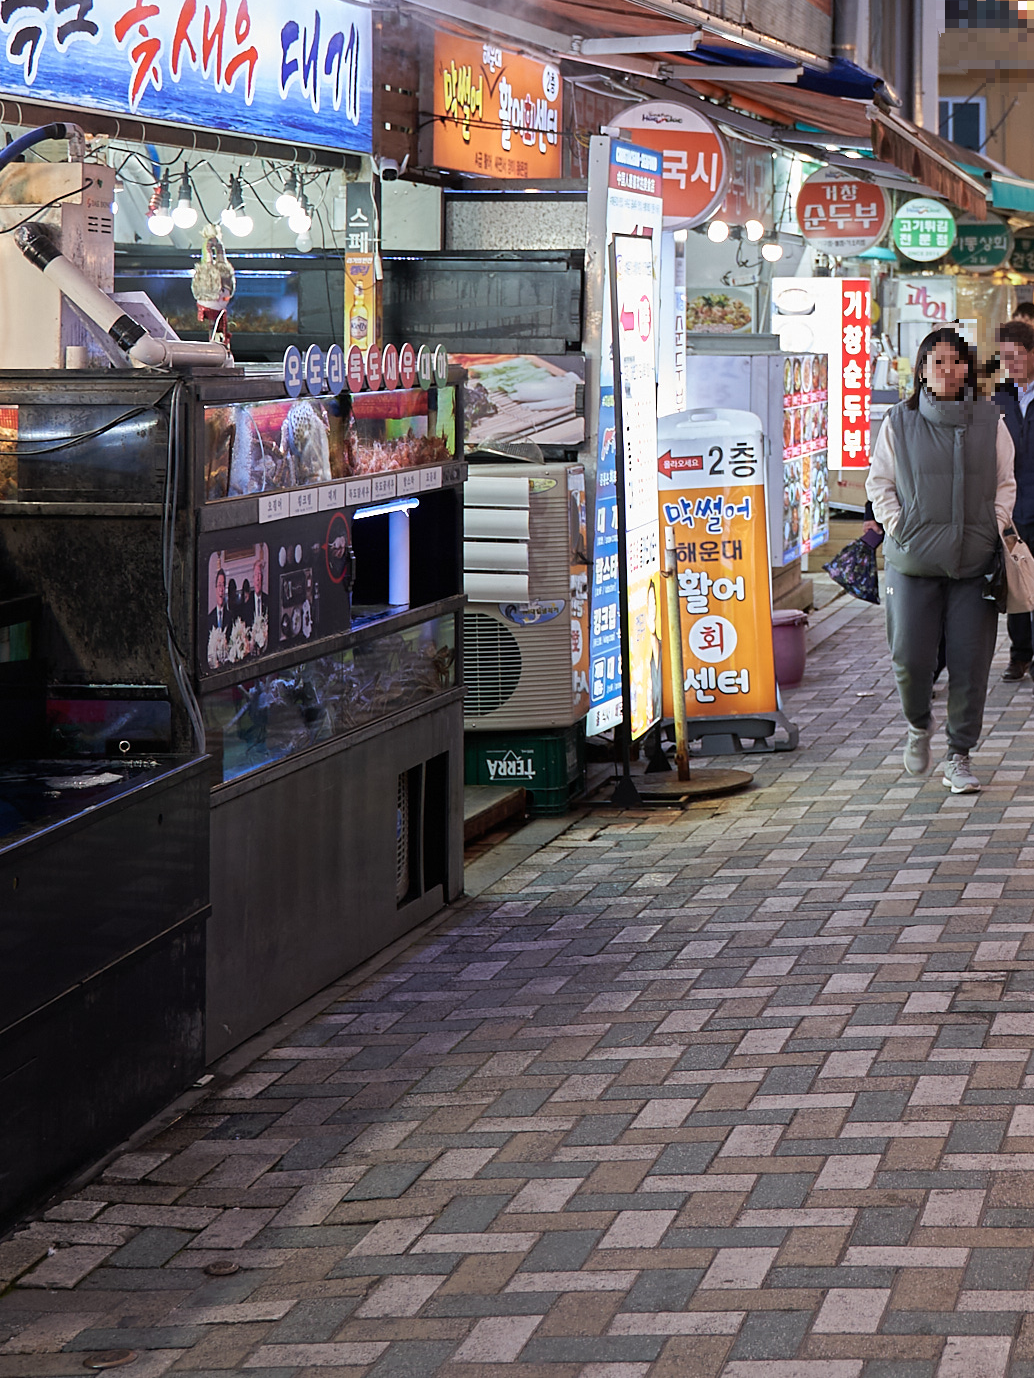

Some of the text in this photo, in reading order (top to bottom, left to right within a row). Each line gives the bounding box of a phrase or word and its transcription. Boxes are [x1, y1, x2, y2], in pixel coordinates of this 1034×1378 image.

[443, 60, 483, 143] 막썰어
[662, 149, 718, 192] 국시
[821, 184, 859, 201] 거창
[803, 203, 879, 231] 순두부
[900, 219, 948, 233] 고기튀김
[905, 283, 947, 321] 과일
[287, 353, 344, 387] 오도리
[842, 290, 863, 459] 거창순두부
[707, 442, 758, 478] 2층
[664, 495, 752, 534] 막썰어
[676, 539, 743, 563] 해운대
[678, 569, 746, 614] 활어
[698, 621, 725, 655] 회
[684, 666, 750, 702] 센터
[486, 747, 536, 771] TERRA
